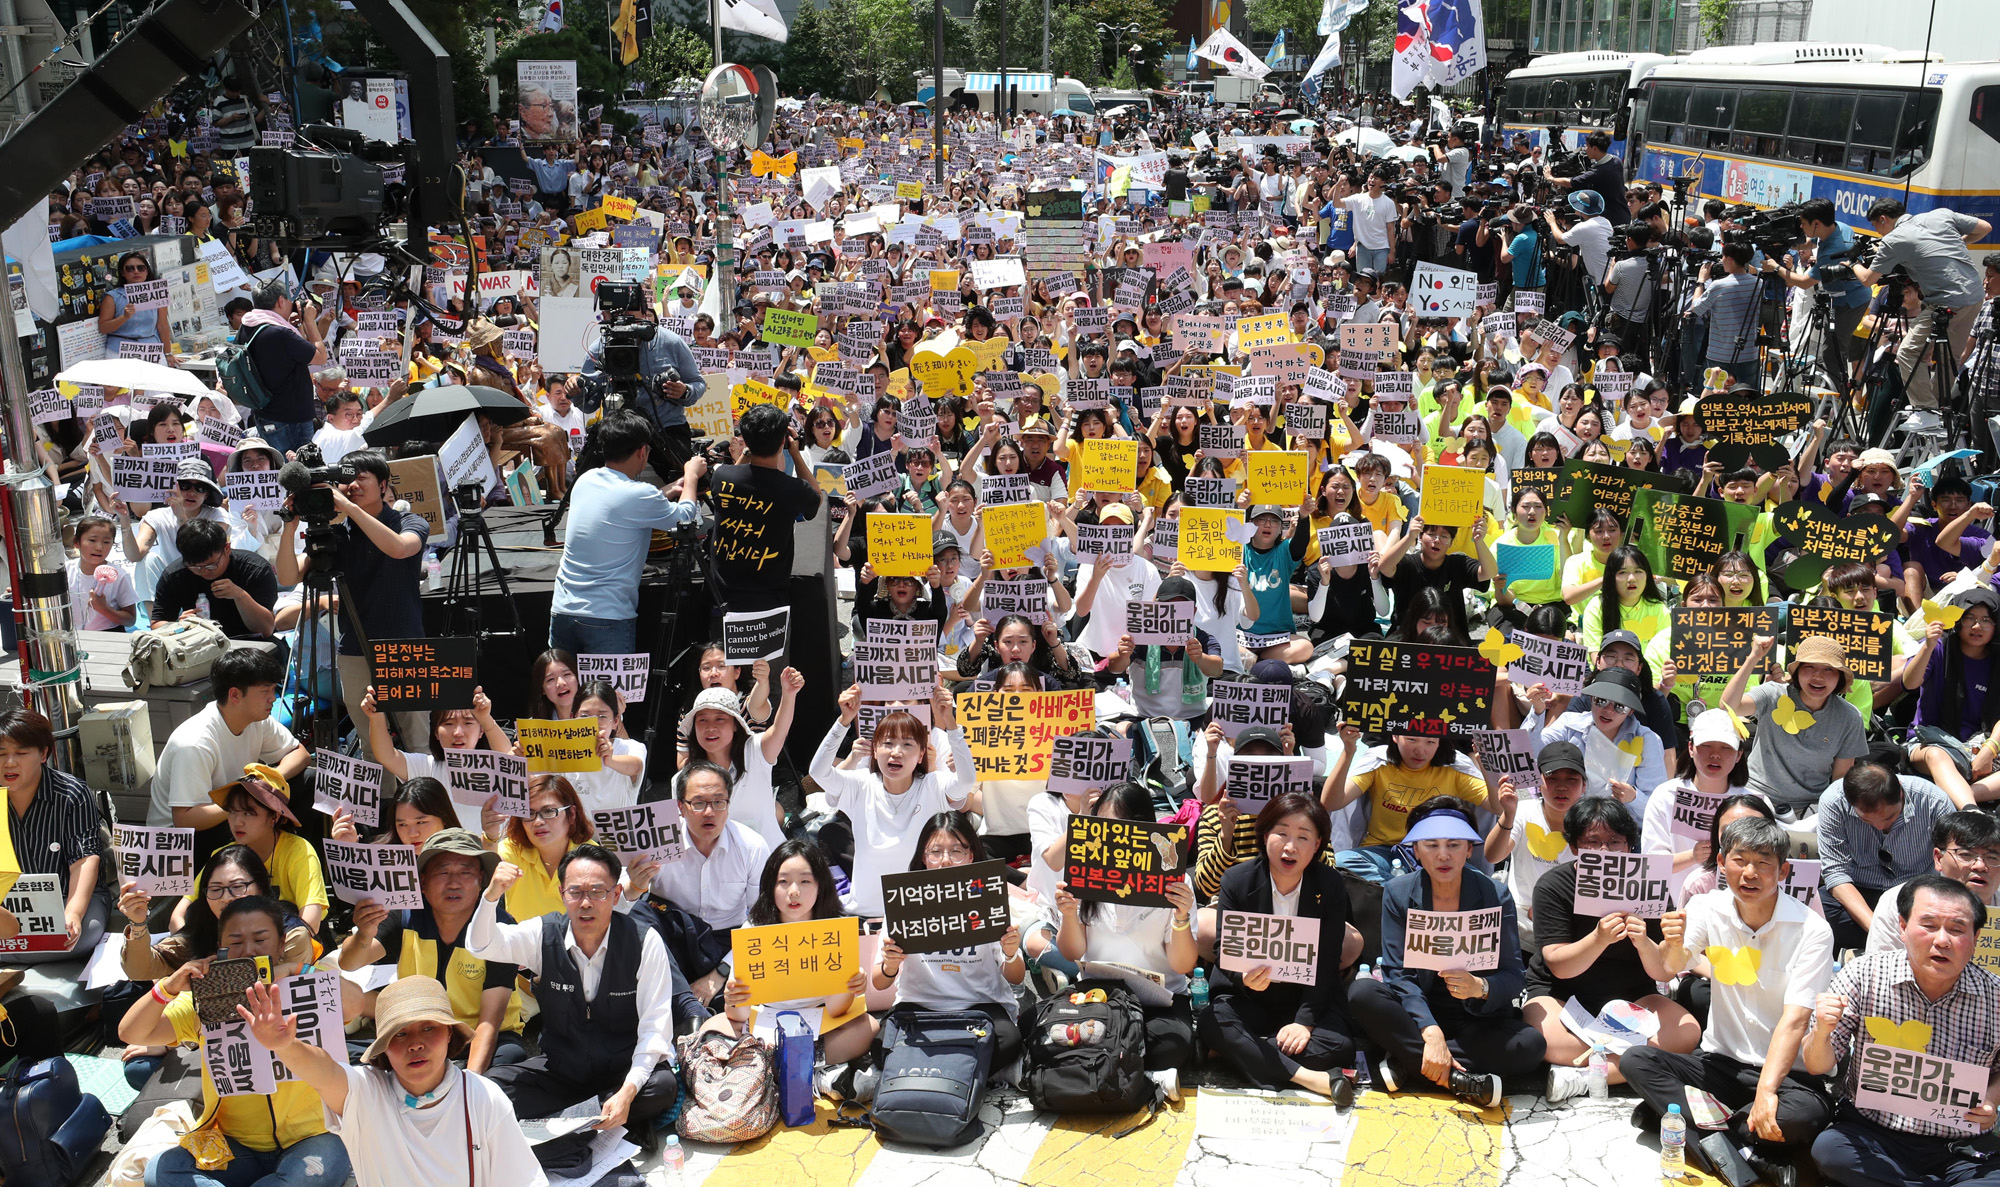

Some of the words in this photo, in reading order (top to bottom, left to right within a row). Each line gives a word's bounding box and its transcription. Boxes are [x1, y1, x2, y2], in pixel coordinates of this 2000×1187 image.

[581, 249, 621, 262] 대한경제
[581, 263, 622, 274] 독립만세!!
[125, 284, 151, 295] 끝까지
[152, 280, 168, 291] 함께
[479, 274, 511, 290] WAR
[128, 290, 169, 306] 싸웁시다
[1328, 294, 1350, 304] 우리가
[1516, 300, 1544, 309] 싸웁시다
[357, 313, 380, 322] 끝까지
[381, 312, 397, 321] 함께
[771, 312, 805, 325] 진심어린
[1075, 309, 1093, 317] 끝까지
[1095, 308, 1108, 316] 함께
[848, 323, 872, 332] 우리가
[1075, 316, 1108, 326] 싸웁시다
[1177, 318, 1220, 329] 할머니에게
[1180, 329, 1207, 339] 명예와
[147, 343, 163, 352] 함께
[1025, 349, 1050, 359] 우리가
[346, 359, 368, 368] 끝까지
[373, 358, 390, 367] 함께
[734, 352, 756, 361] 끝까지
[757, 353, 772, 361] 함께
[1025, 357, 1058, 367] 증인이다
[1264, 357, 1305, 369] 기억하는
[1193, 377, 1210, 387] 함께
[1235, 379, 1256, 389] 끝까지
[1259, 378, 1275, 387] 함께
[1287, 371, 1306, 382] 있다
[1594, 374, 1615, 382] 끝까지
[1618, 373, 1633, 381] 함께
[1067, 381, 1098, 391] 우리가
[1087, 440, 1121, 452] 인정하지
[1722, 432, 1774, 446] 기록해라
[341, 465, 356, 476] KBS
[1255, 464, 1297, 477] 지울수록
[1512, 470, 1545, 484] 평화와
[114, 472, 176, 491] 싸웁시다
[1429, 476, 1476, 495] 일본정부는
[1584, 473, 1626, 488] 사과가
[1593, 488, 1631, 505] 어려운
[1424, 499, 1480, 515] 사죄하라!
[720, 516, 767, 538] 싸워
[1187, 518, 1223, 532] 오늘이
[1653, 516, 1717, 538] 일본정부의
[874, 535, 894, 547] 역사
[896, 535, 918, 547] 앞에
[1187, 532, 1224, 545] 마지막
[1806, 520, 1869, 547] 전범자를
[871, 551, 898, 564] 일본은
[1185, 546, 1216, 561] 수요일
[1802, 540, 1867, 562] 처벌하라
[1000, 556, 1013, 566] NO
[1127, 602, 1176, 620] 우리가
[727, 624, 744, 632] The
[745, 621, 767, 632] truth
[1127, 619, 1193, 636] 증인이다
[1677, 611, 1732, 629] 저희가
[1737, 610, 1773, 632] 계속
[1790, 607, 1869, 633] 일본정부는
[727, 633, 757, 644] cannot
[759, 631, 768, 640] be
[768, 625, 786, 639] veiled
[1694, 631, 1748, 649] 위드유
[374, 643, 436, 663] 일본정부는
[728, 644, 760, 654] forever
[855, 647, 900, 662] 끝까지
[904, 646, 937, 662] 함께
[1416, 651, 1491, 673] 우긴다고
[375, 667, 428, 679] 피해자의
[430, 665, 473, 679] 목소리를
[856, 665, 937, 685] 싸웁시다
[377, 684, 422, 701] 들어라
[1353, 678, 1429, 695] 가려지지
[1439, 682, 1489, 699] 않는다
[962, 693, 1024, 721] 진실은
[1029, 690, 1094, 721] 아베정부
[1213, 703, 1288, 726] 싸웁시다
[520, 726, 562, 740] 피해자가
[1386, 719, 1409, 733] 앞에
[1407, 718, 1448, 736] 사죄
[525, 743, 544, 760] 왜
[1054, 739, 1113, 761] 우리가
[1014, 754, 1028, 776] 것
[1051, 760, 1128, 781] 증인이다
[1229, 762, 1292, 783] 우리가
[594, 806, 656, 831] 우리가
[1069, 843, 1110, 866] 역사
[1114, 848, 1152, 872] 앞에
[1579, 851, 1650, 879] 우리가
[330, 864, 418, 892] 싸웁시다
[1068, 865, 1123, 892] 일본은
[886, 881, 962, 907] 기억하라
[964, 874, 1004, 902] 한국
[1577, 877, 1669, 902] 증인이다
[889, 913, 968, 940] 사죄하라
[1223, 913, 1295, 941] 우리가
[1408, 912, 1463, 933] 끝까지
[1468, 910, 1501, 931] 함께
[1222, 936, 1316, 965] 증인이다
[1406, 931, 1500, 956] 싸웁시다
[1863, 1046, 1955, 1086] 우리가
[1860, 1068, 1982, 1110] 증인이다
